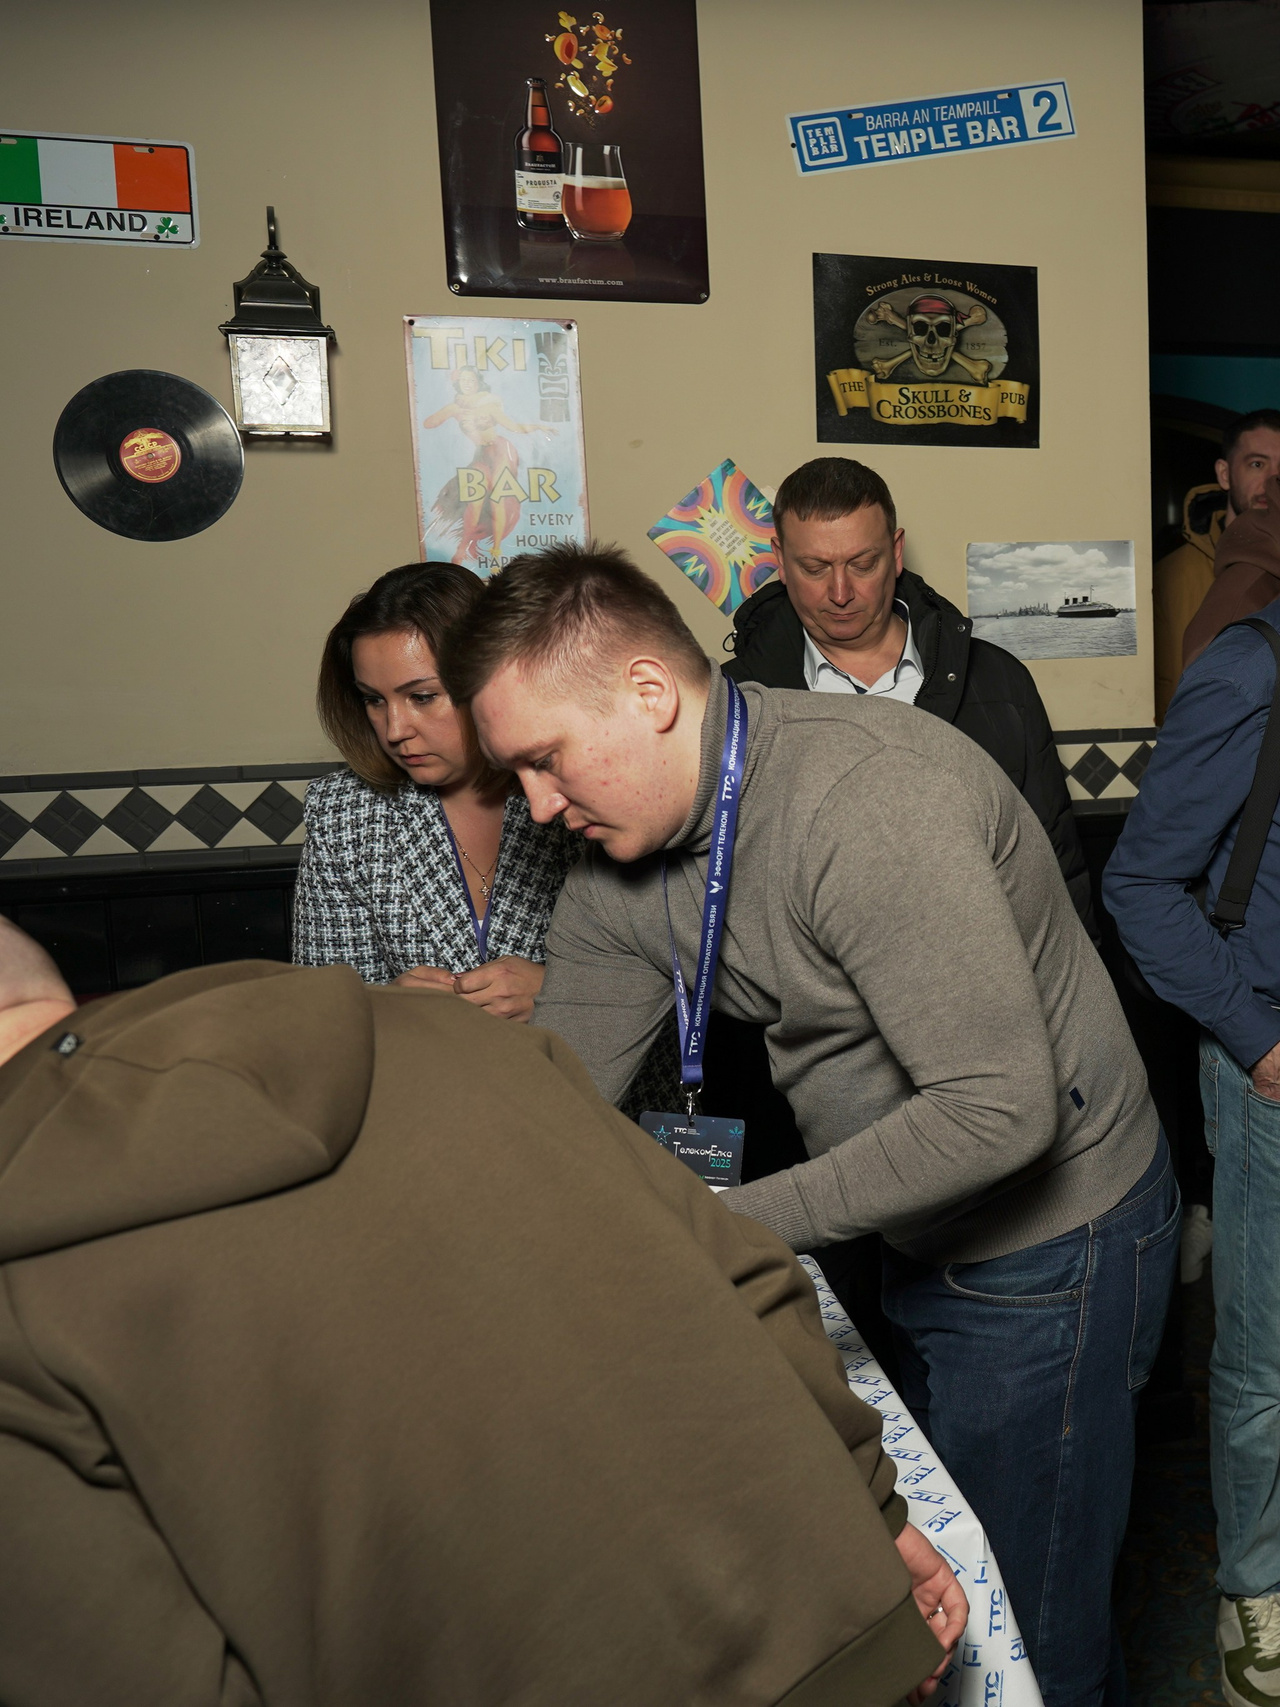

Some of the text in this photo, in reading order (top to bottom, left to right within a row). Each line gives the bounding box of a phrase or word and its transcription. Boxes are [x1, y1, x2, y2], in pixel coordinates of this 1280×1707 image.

[866, 90, 1063, 133] BARRA AN TEAMPAILL 2
[806, 126, 835, 136] TEM
[810, 135, 837, 148] PLE
[854, 115, 1021, 159] TEMPLE BAR
[811, 144, 839, 156] BAR
[14, 207, 147, 232] IRELAND
[538, 277, 624, 286] www.braufactum.com
[865, 273, 998, 305] Strong Ales & Loose Women
[412, 327, 526, 372] TIKI
[840, 381, 865, 393] THE
[898, 387, 972, 405] SKULL &
[876, 399, 992, 421] CROSSBONES
[1000, 392, 1026, 406] PUB
[456, 466, 562, 504] BAR
[530, 513, 574, 526] EVERY
[516, 535, 558, 547] HOUR
[727, 719, 741, 771] КОНФЕРЕНЦИЯ
[714, 810, 729, 877] ЭФФОРТ ТЕЛЕКОМ
[694, 975, 708, 1027] КОНФЕРЕНЦИЯ
[702, 928, 714, 974] ОПЕРАТОРОВ
[708, 905, 717, 928] СВЯЗИ
[710, 1158, 731, 1168] 2025
[984, 1671, 999, 1707] ТС
